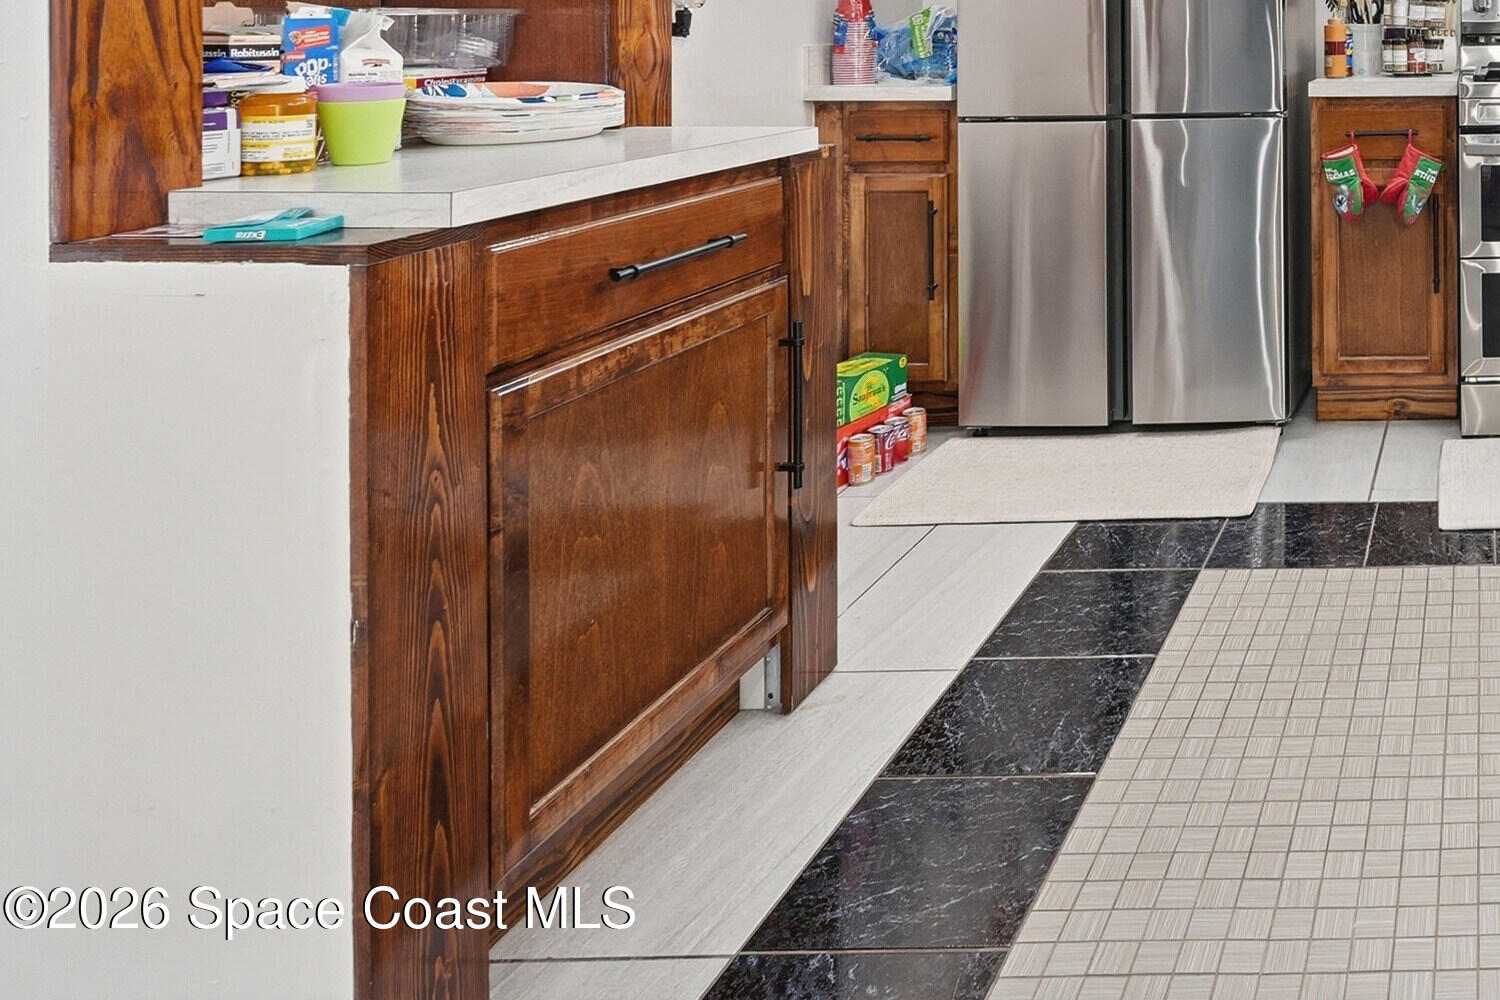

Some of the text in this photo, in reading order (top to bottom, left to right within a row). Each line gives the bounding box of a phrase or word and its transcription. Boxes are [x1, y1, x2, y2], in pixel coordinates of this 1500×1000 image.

[202, 49, 227, 58] ussin
[230, 48, 280, 58] Robitussin
[306, 73, 328, 88] arts
